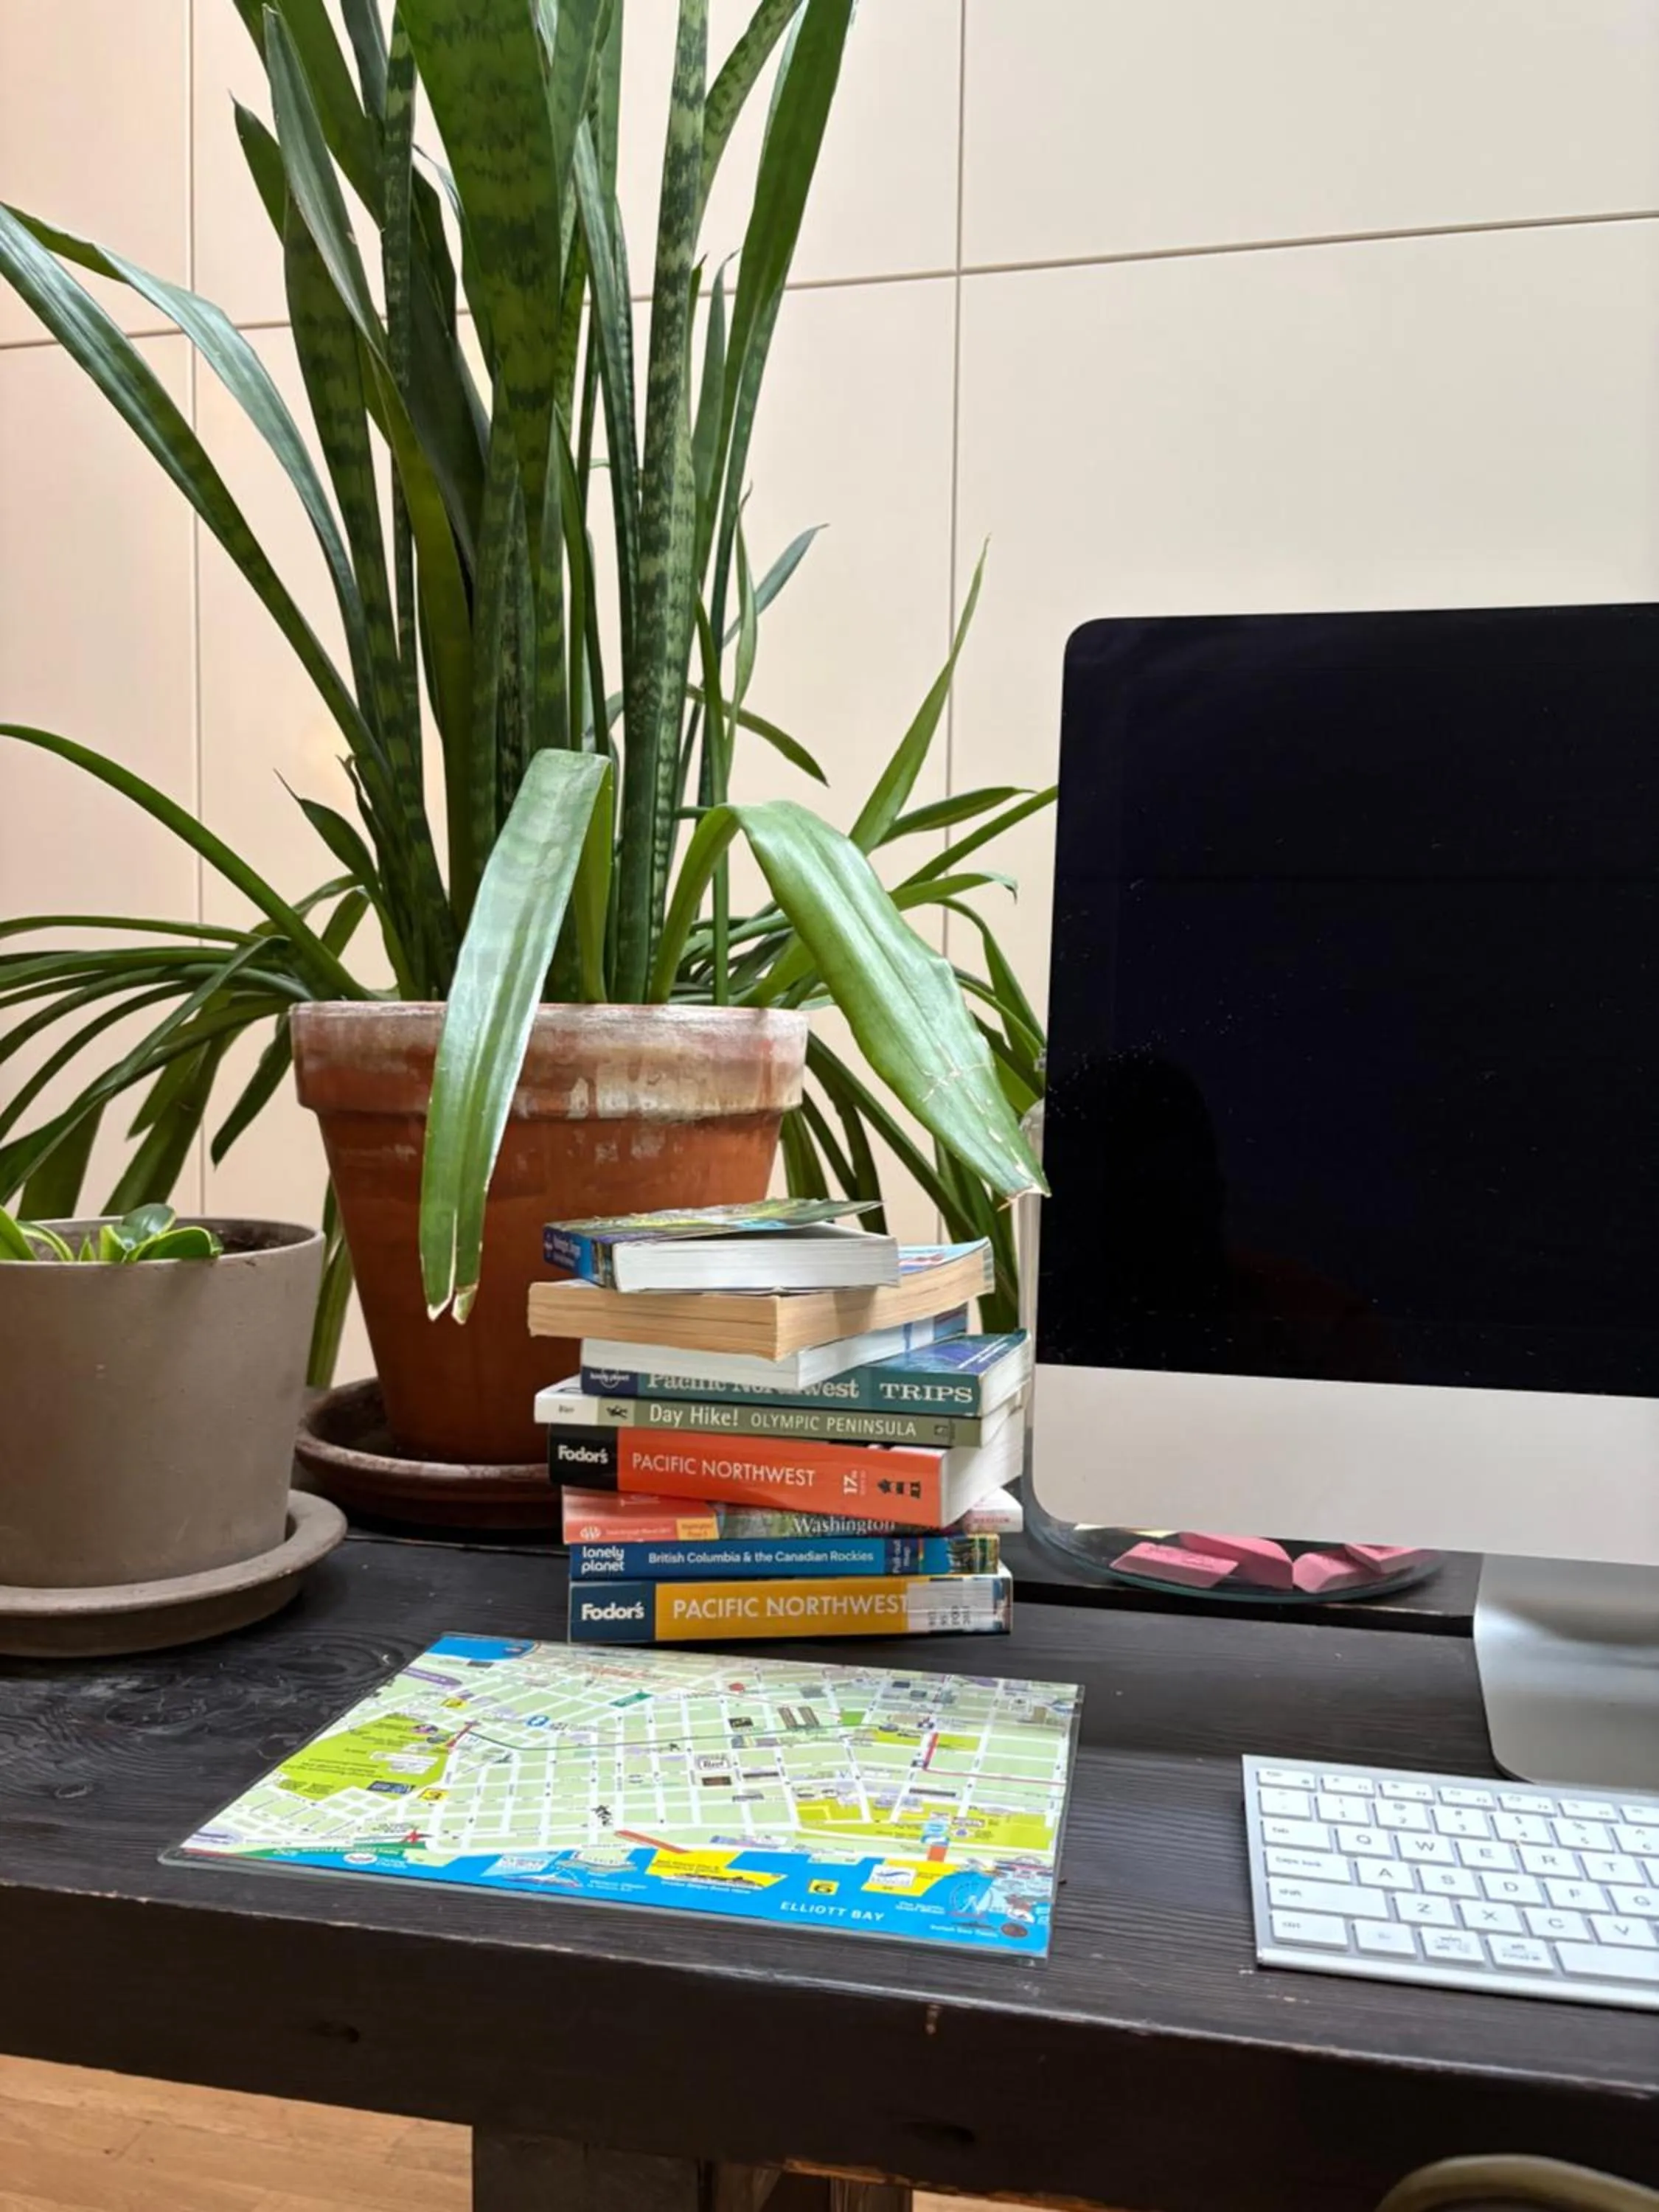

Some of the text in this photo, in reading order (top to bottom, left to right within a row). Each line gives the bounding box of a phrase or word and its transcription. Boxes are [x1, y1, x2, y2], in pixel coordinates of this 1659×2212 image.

[879, 1383, 973, 1403] TRIPS
[650, 1404, 917, 1437] Day Hike! OLYMPIC PENINSULA
[558, 1444, 609, 1464] Fodor's
[632, 1452, 815, 1487] PACIFIC NORTHWEST
[793, 1515, 896, 1535] Washington
[582, 1545, 625, 1561] lonely
[648, 1550, 874, 1564] British Columbia & the Canadian Rockies
[581, 1560, 625, 1574] planet
[581, 1601, 645, 1621] Fodor's
[673, 1593, 908, 1620] PACIFIC NORTHWEST
[1356, 1834, 1372, 1845] Q
[1415, 1840, 1435, 1852] W
[1479, 1848, 1495, 1860] E
[1541, 1855, 1558, 1866] R
[1604, 1862, 1618, 1872] T
[1377, 1868, 1394, 1879] A
[1440, 1874, 1455, 1885] S
[1503, 1881, 1519, 1893] D
[1569, 1888, 1582, 1899] F
[780, 1901, 885, 1921] ELLIOTT BAY
[1416, 1902, 1432, 1914] Z
[1481, 1909, 1499, 1922] X
[1548, 1917, 1565, 1929] C
[1613, 1924, 1630, 1936] V
